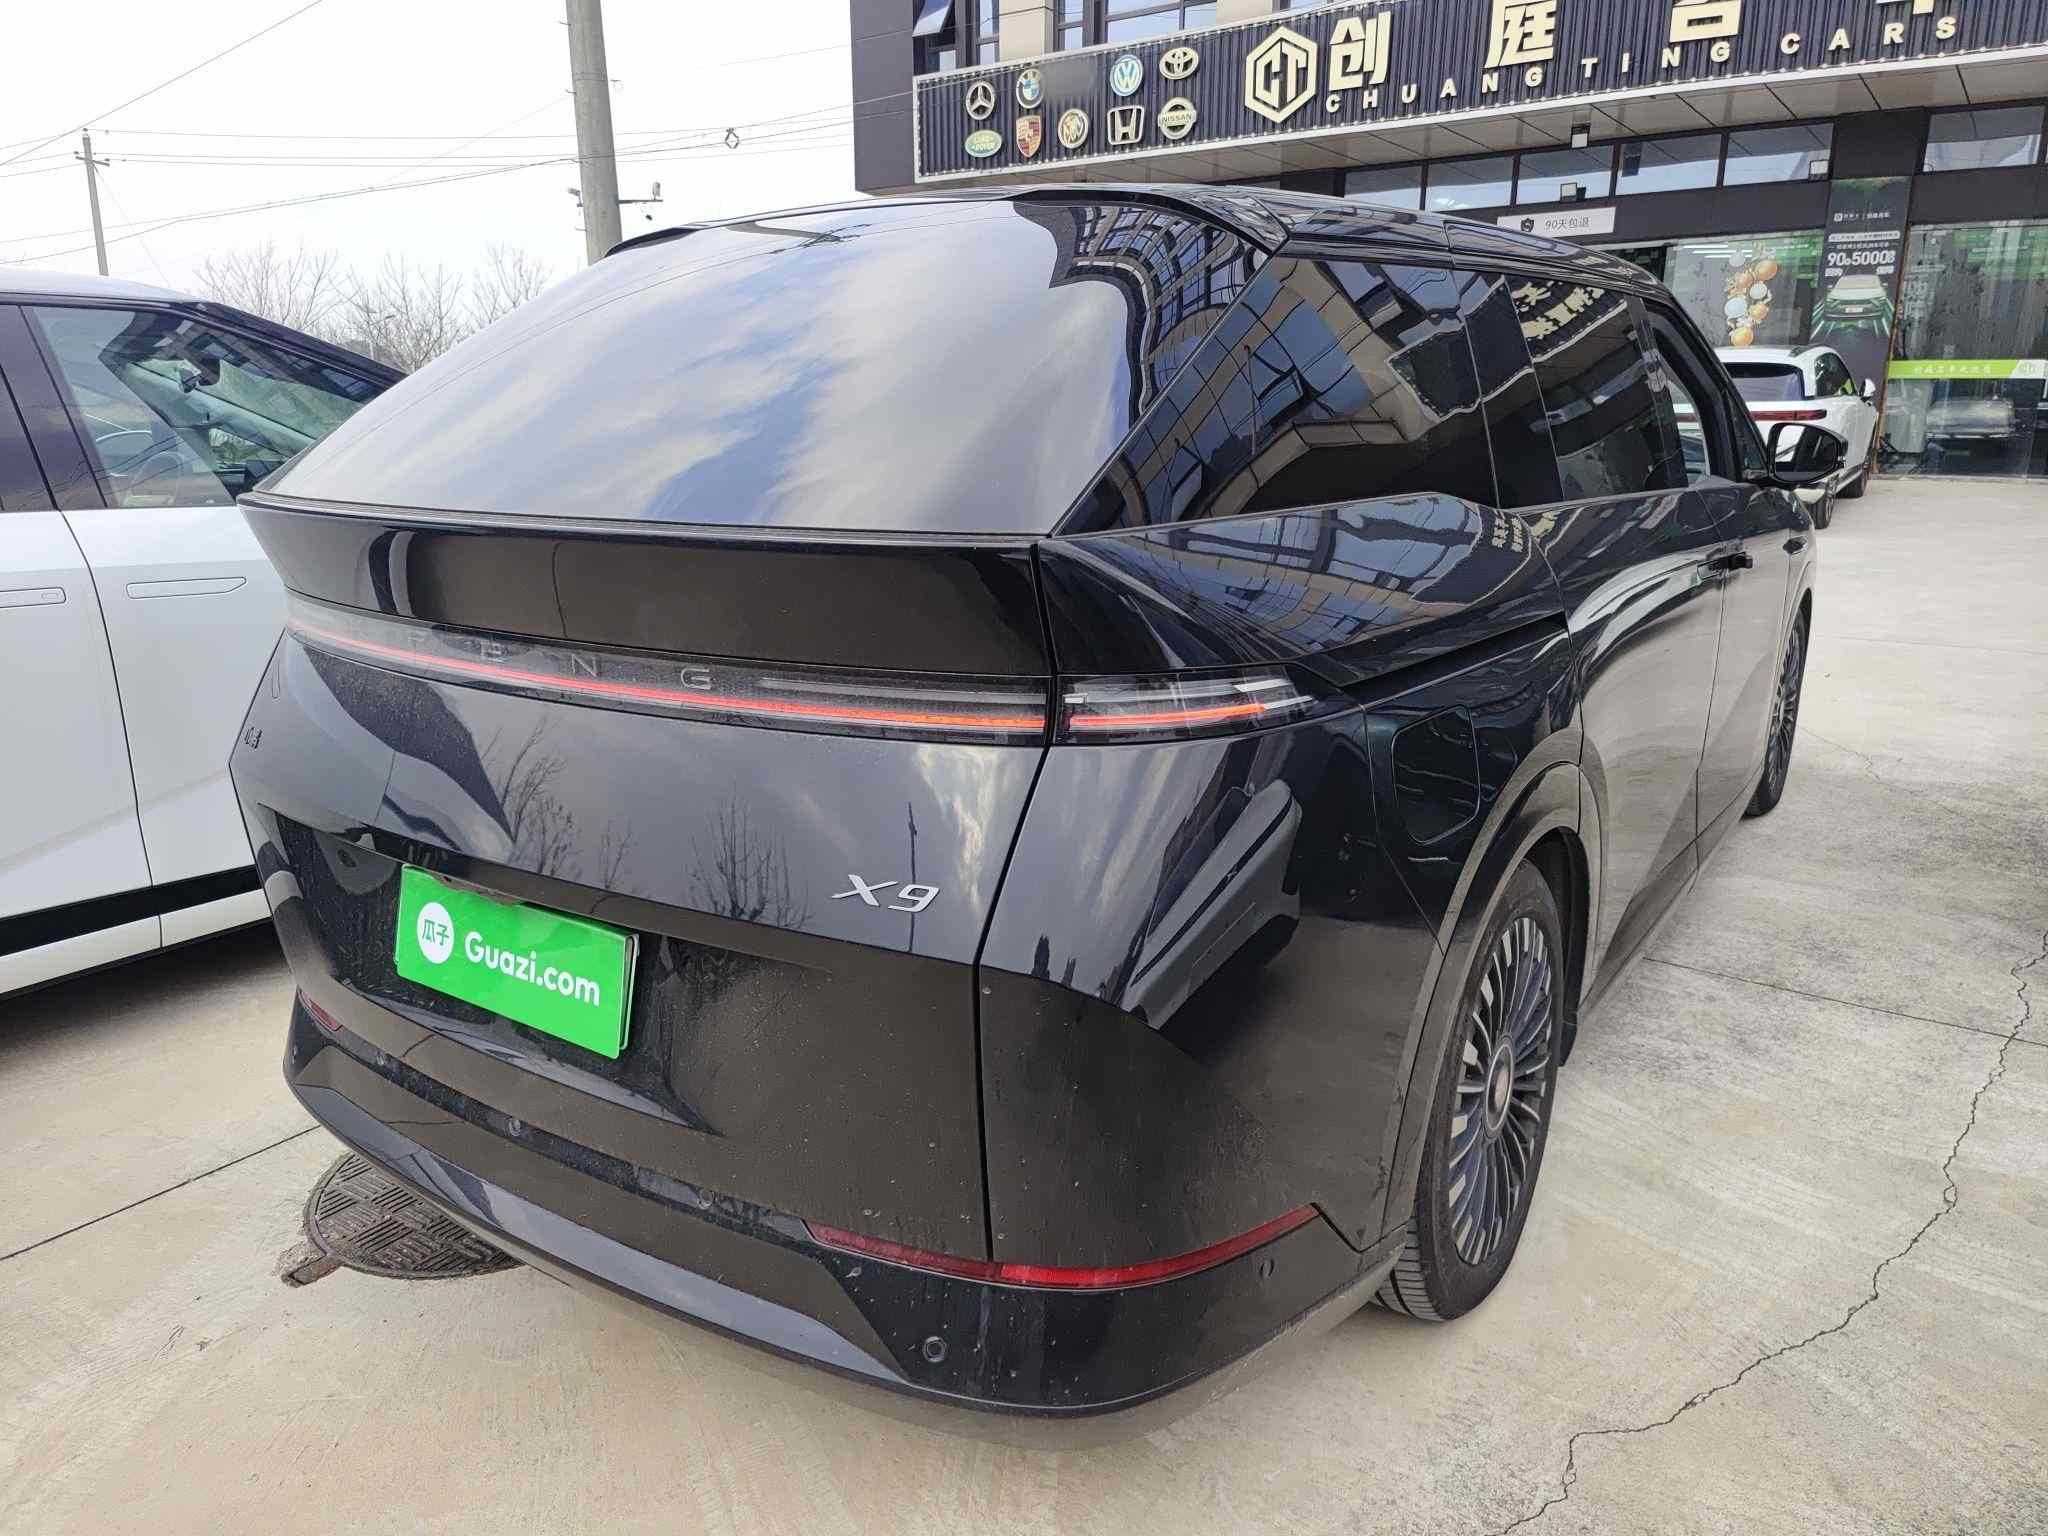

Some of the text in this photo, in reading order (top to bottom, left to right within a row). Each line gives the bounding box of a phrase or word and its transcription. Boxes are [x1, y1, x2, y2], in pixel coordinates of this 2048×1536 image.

[1326, 16, 1956, 113] CHUANG TING CARS
[831, 874, 940, 913] X9
[422, 919, 450, 946] 瓜子
[464, 931, 600, 1006] Guazi.com
